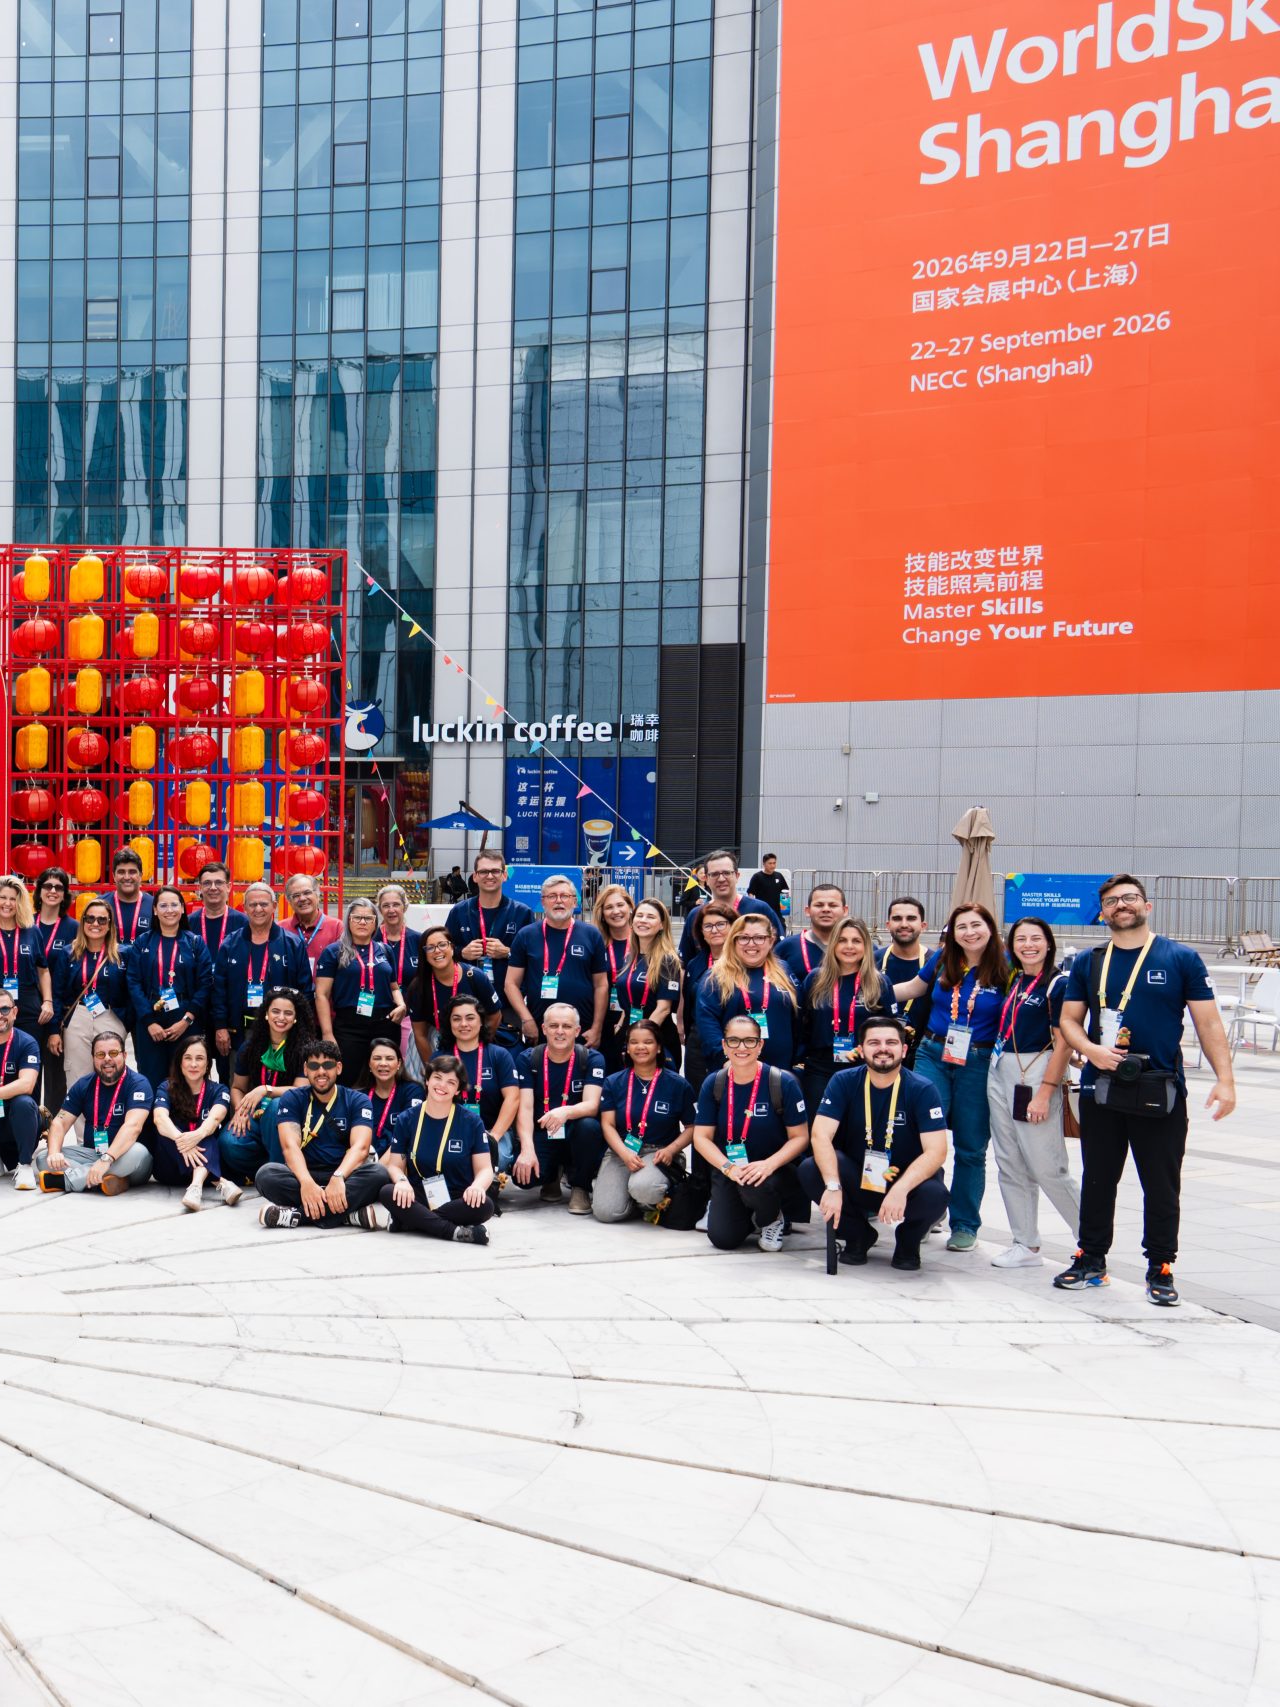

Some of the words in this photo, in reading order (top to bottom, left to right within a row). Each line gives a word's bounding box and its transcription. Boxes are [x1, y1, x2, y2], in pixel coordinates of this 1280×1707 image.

[919, 72, 1280, 185] Shangha
[911, 261, 1138, 313] 国家会展中心（上海）
[980, 323, 1106, 353] September
[1113, 310, 1171, 336] 2026
[910, 370, 967, 392] NECC
[976, 354, 1093, 387] (Shanghai)
[905, 545, 1044, 574] 技能改变世界
[904, 570, 1043, 597] 技能照亮前程
[903, 603, 975, 620] Master
[981, 597, 1043, 616] Skills
[902, 626, 981, 646] Change
[988, 623, 1046, 640] Your
[1053, 620, 1134, 637] Future
[412, 715, 503, 742] luckin
[513, 714, 612, 742] coffee
[630, 714, 660, 727] 瑞幸
[630, 728, 660, 742] 咖啡
[517, 782, 555, 793] 这一杯
